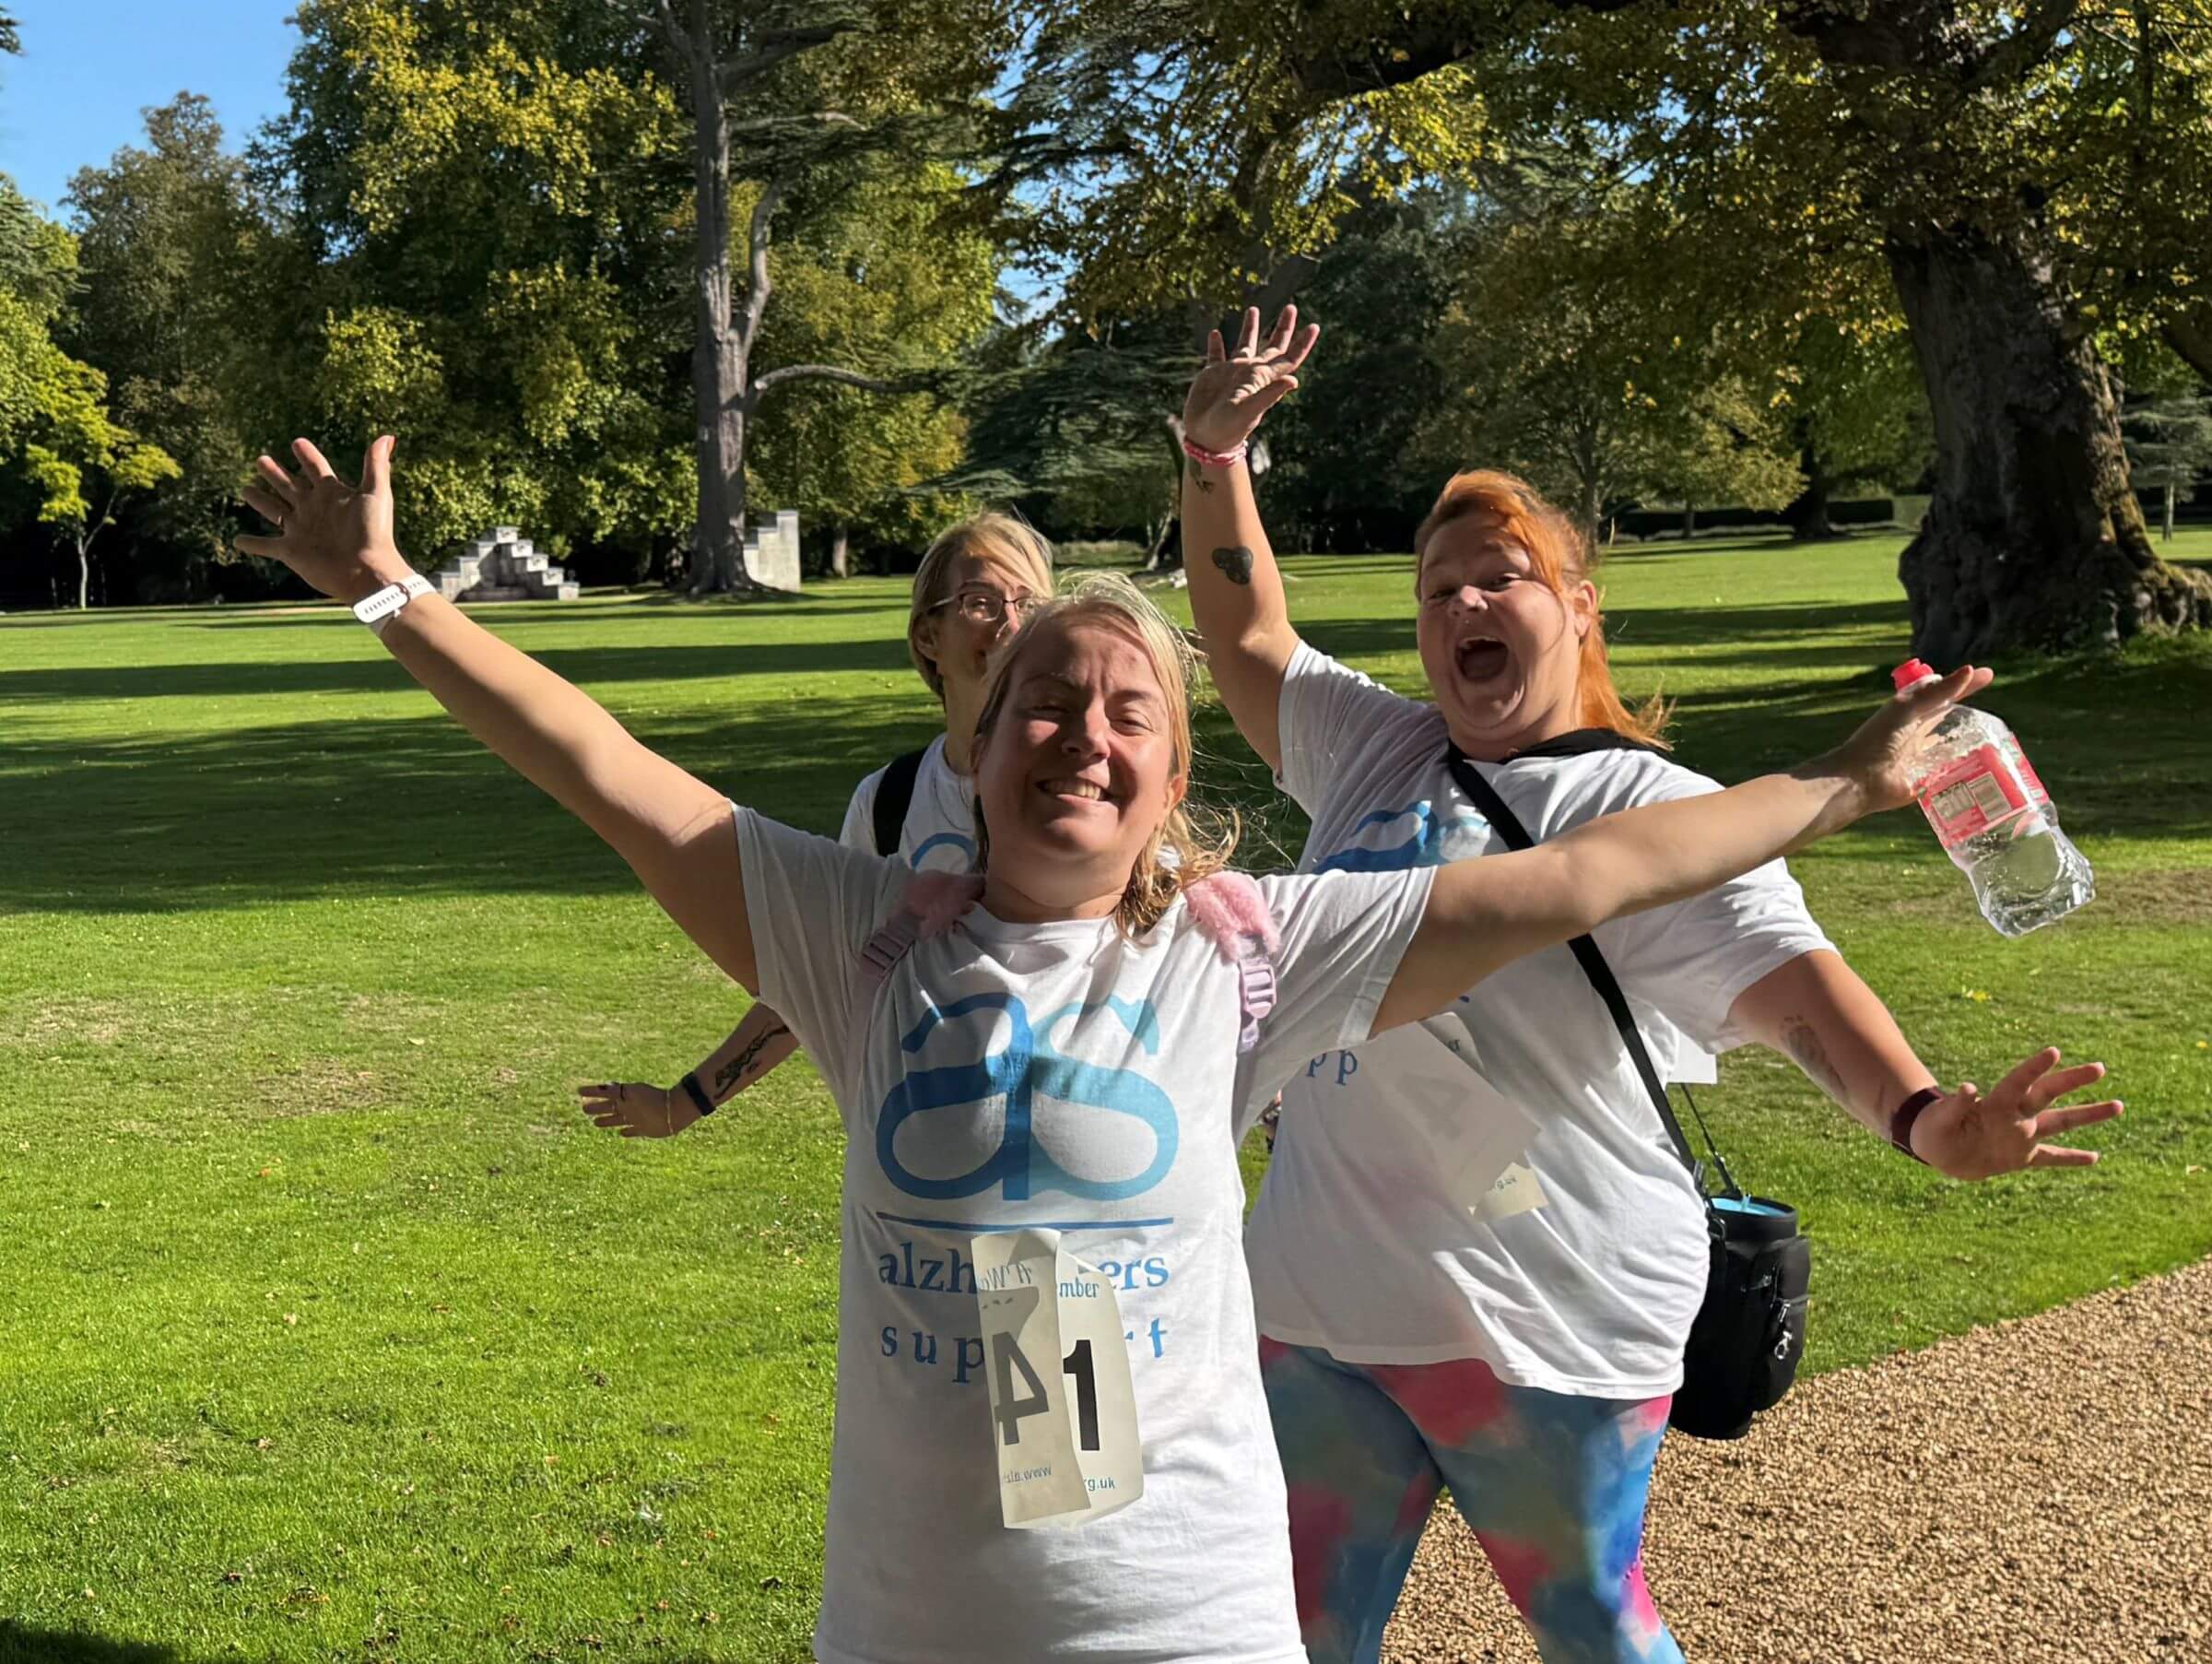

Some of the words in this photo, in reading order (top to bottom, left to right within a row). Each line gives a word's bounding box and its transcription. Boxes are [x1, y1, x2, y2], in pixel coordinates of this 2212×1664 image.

[878, 1242, 1171, 1294] alzhers
[1058, 1277, 1100, 1298] mber
[881, 1318, 1168, 1383] supt
[1063, 1339, 1100, 1451] 1
